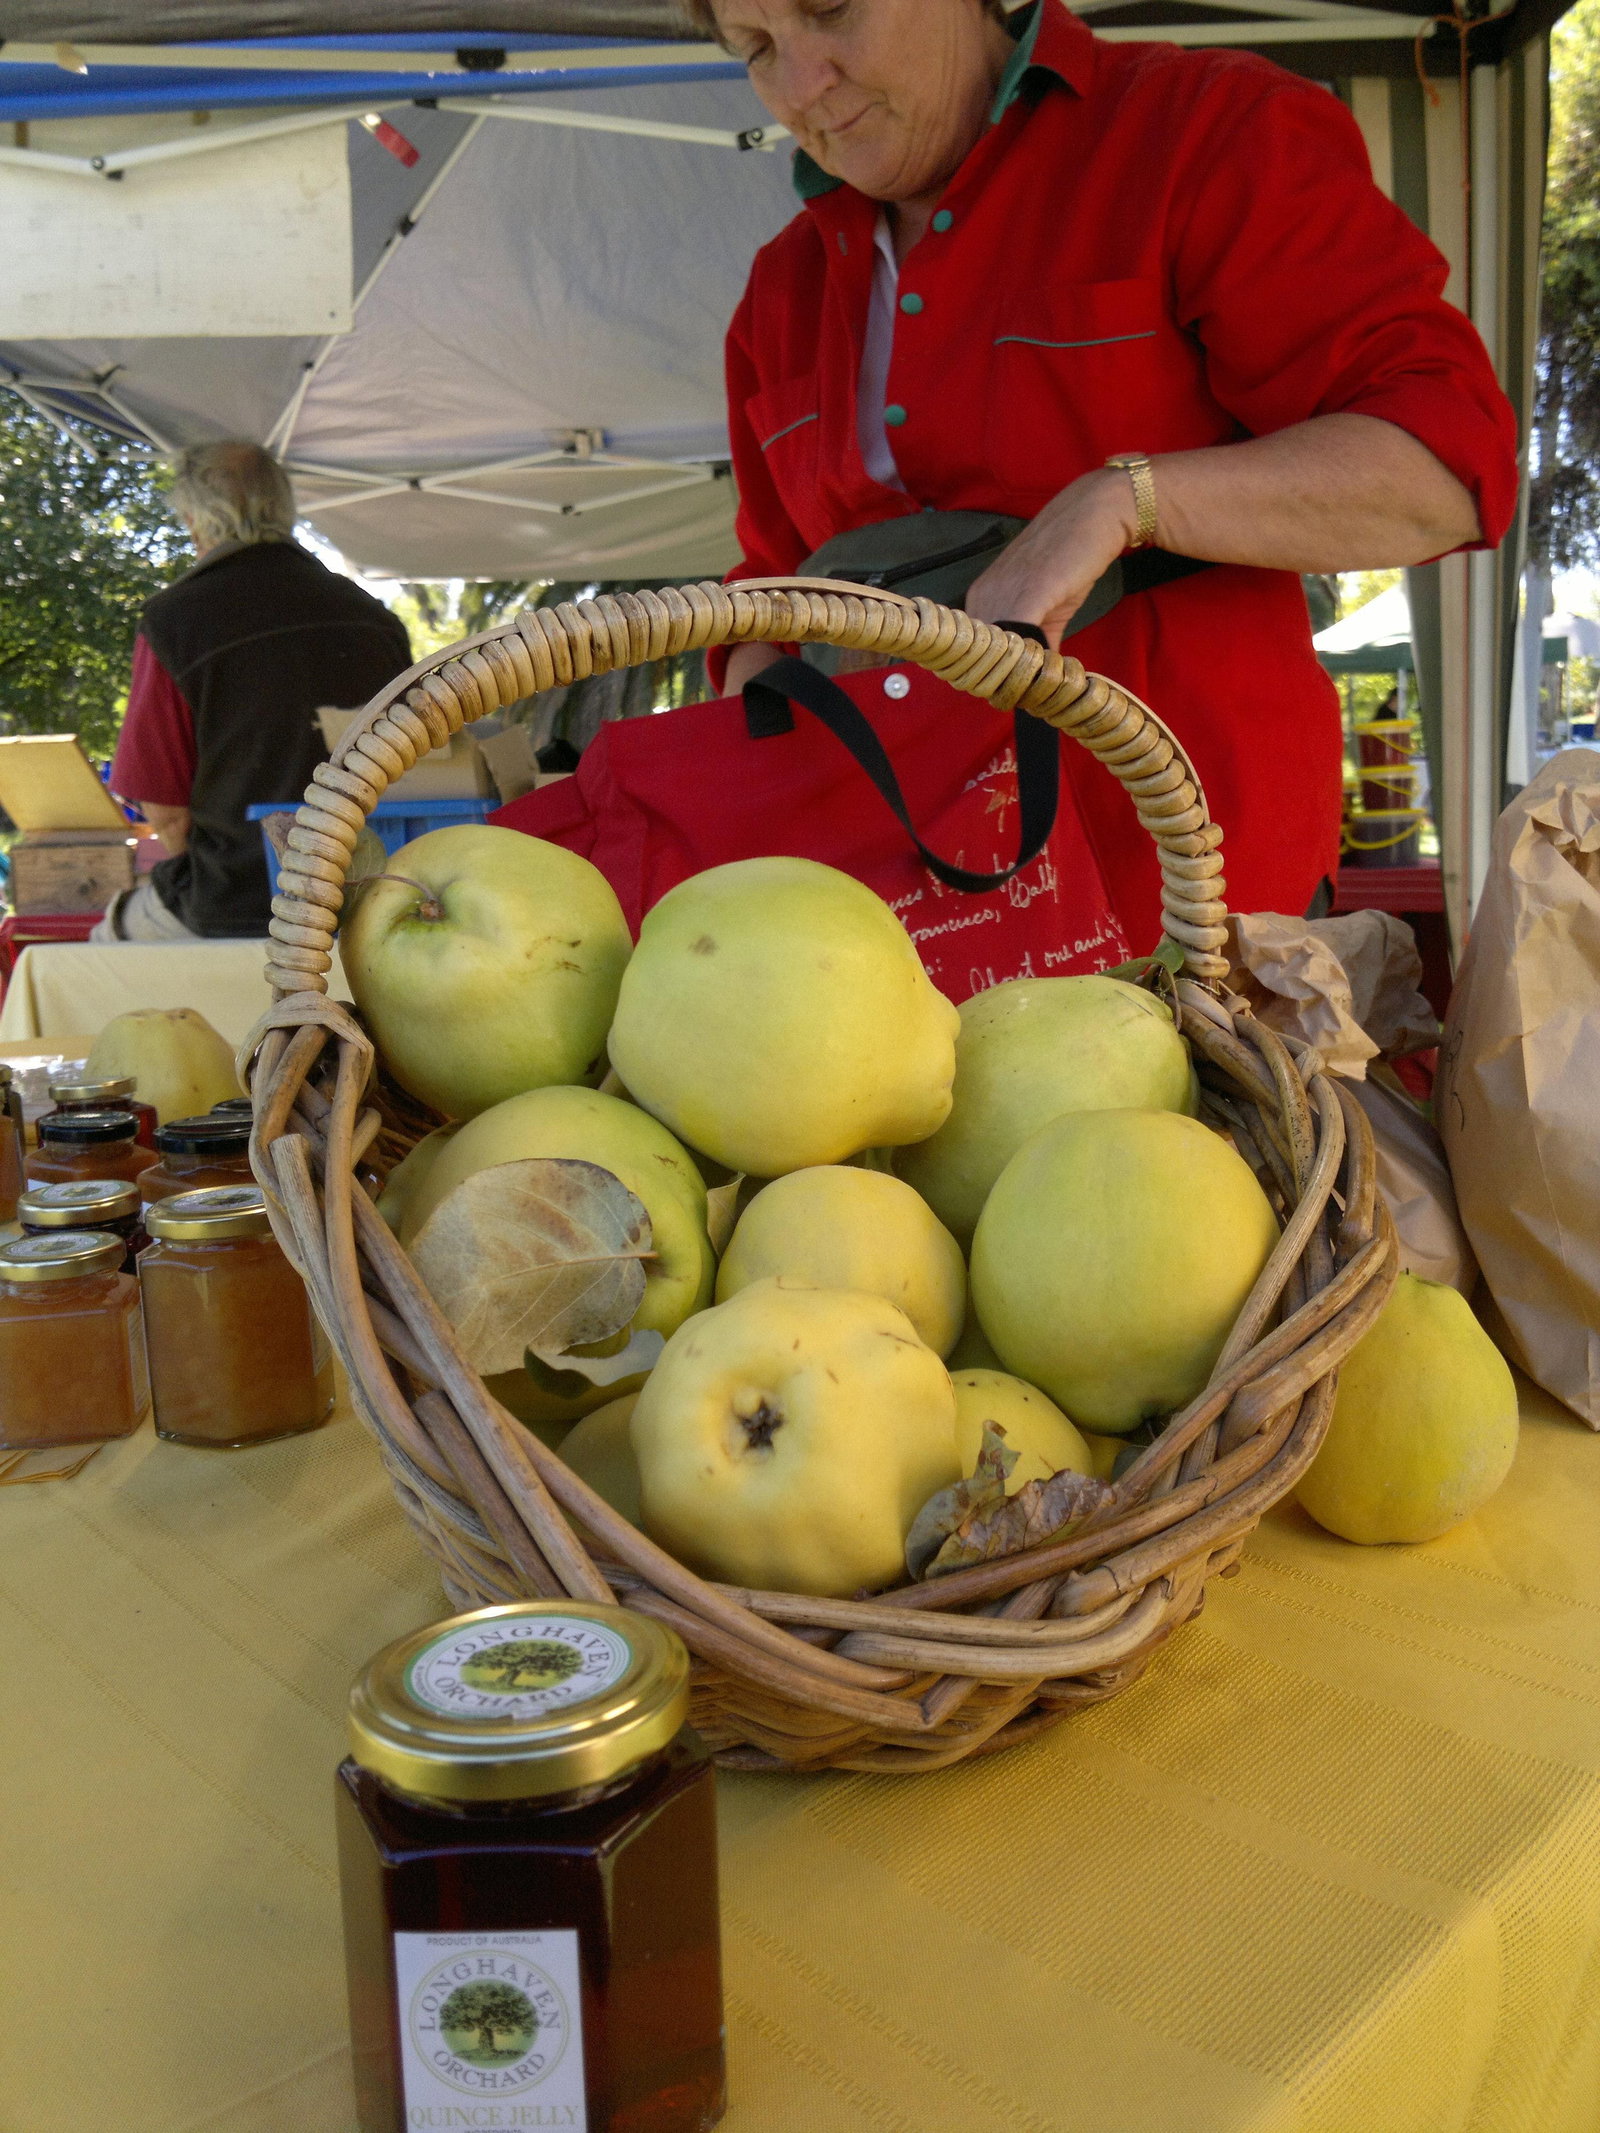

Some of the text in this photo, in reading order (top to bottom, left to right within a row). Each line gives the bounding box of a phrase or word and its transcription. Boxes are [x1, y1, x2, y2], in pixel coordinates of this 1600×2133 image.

[437, 1626, 610, 1679] LONGHAVEN
[435, 1676, 572, 1707] ORCHARD
[426, 1935, 542, 1946] PRODUCT OF AUSTRALIA
[419, 1958, 561, 2032] LONGHAVEN
[434, 2051, 546, 2088] ORCHARD
[409, 2105, 578, 2129] QUINCE JELLY
